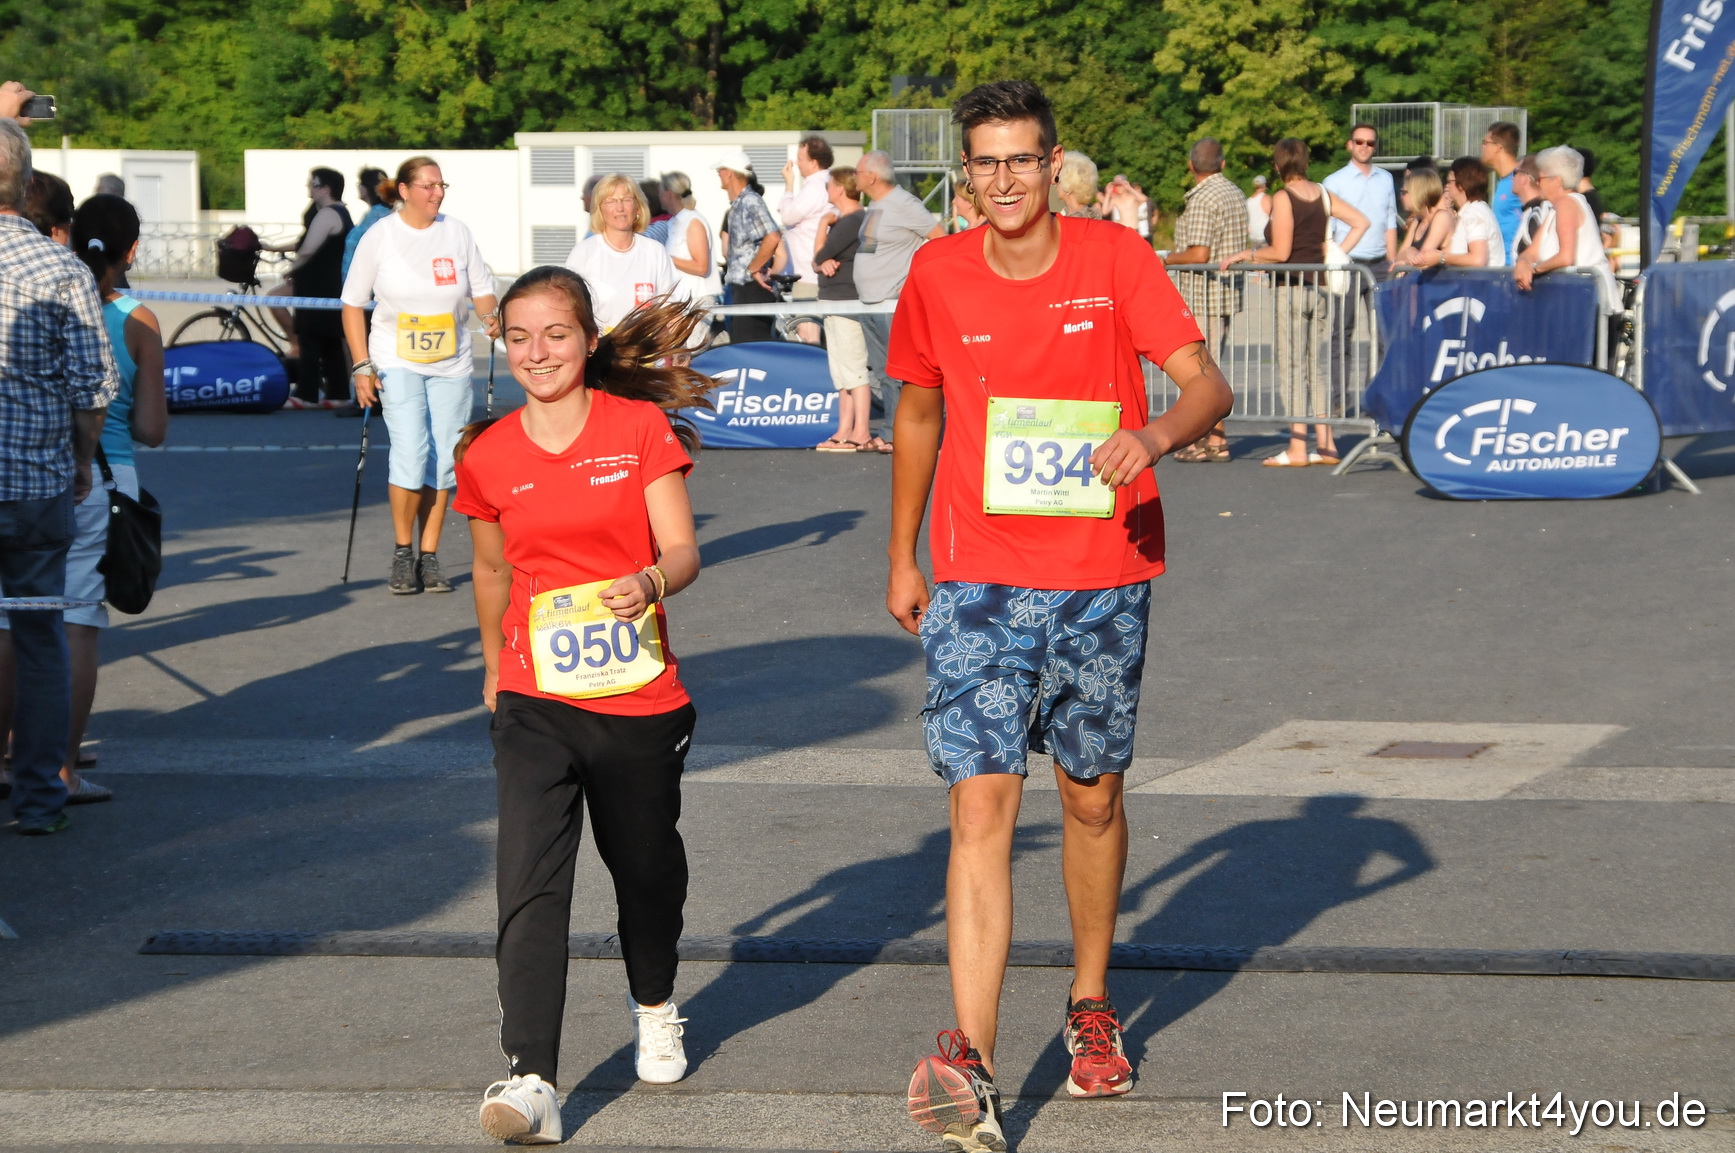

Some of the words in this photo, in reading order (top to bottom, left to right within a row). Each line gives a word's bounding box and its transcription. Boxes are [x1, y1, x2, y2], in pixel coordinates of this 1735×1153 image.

[1063, 320, 1093, 335] Martin
[406, 331, 446, 351] 157
[971, 334, 991, 343] JAKO
[717, 388, 840, 415] Fischer
[727, 413, 830, 426] AUTOMOBILE
[1470, 423, 1629, 456] Fischer
[1004, 440, 1096, 487] 934
[1485, 454, 1618, 472] AUTOMOBILE
[590, 469, 629, 486] Franziska
[519, 483, 534, 492] JAKO
[1030, 488, 1052, 496] Martin
[1035, 499, 1052, 507] Petry
[547, 602, 591, 617] firmenlauf
[536, 619, 572, 632] walken
[549, 621, 640, 673] 950
[575, 668, 609, 680] Franziska
[609, 667, 627, 675] Tratz
